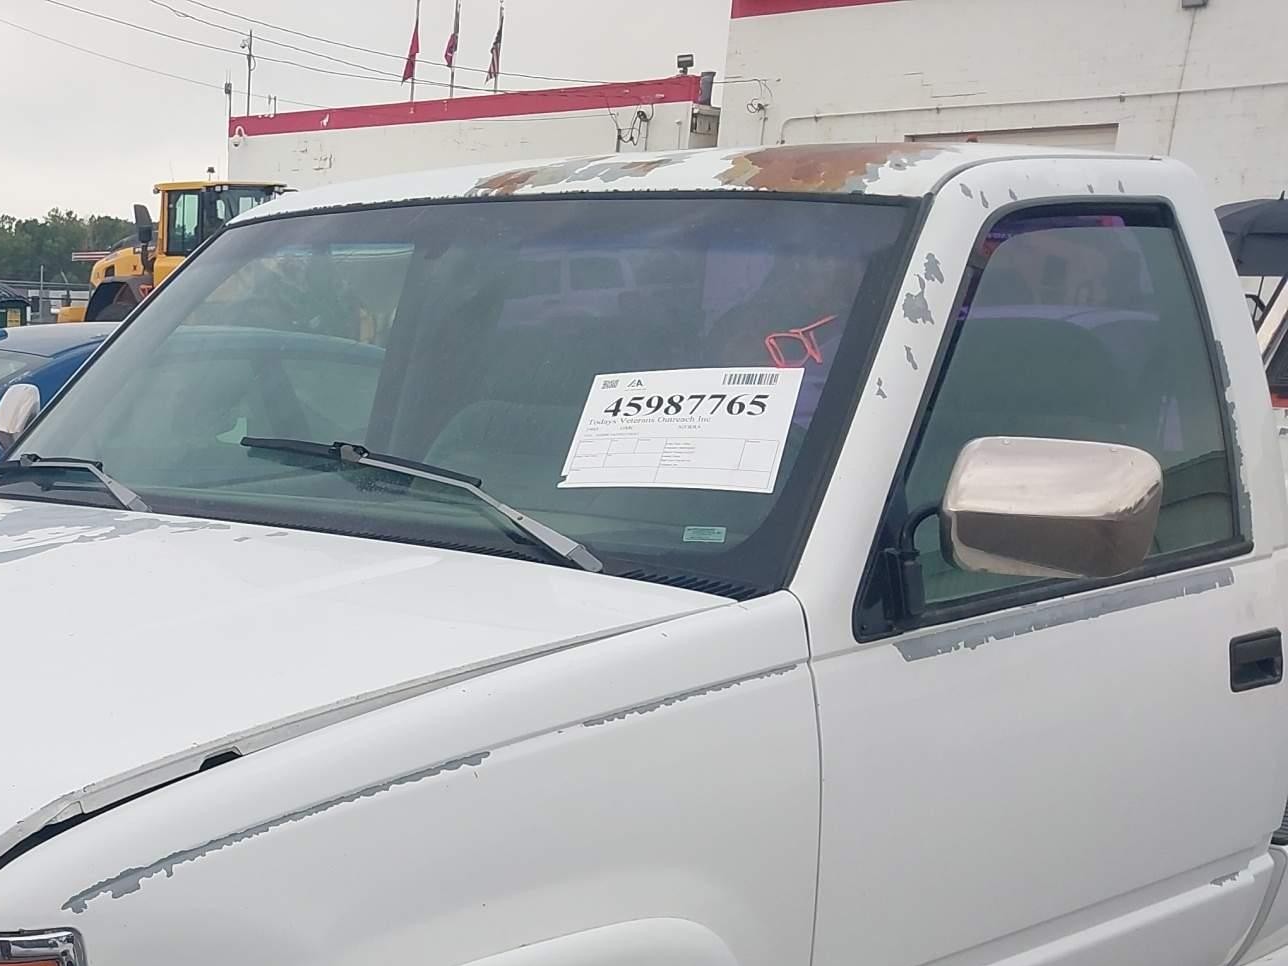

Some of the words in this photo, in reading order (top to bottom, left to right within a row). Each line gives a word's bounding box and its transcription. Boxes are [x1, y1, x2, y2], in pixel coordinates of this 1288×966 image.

[603, 393, 770, 417] 45987765
[620, 416, 655, 425] Veterans
[657, 415, 695, 423] Outreach
